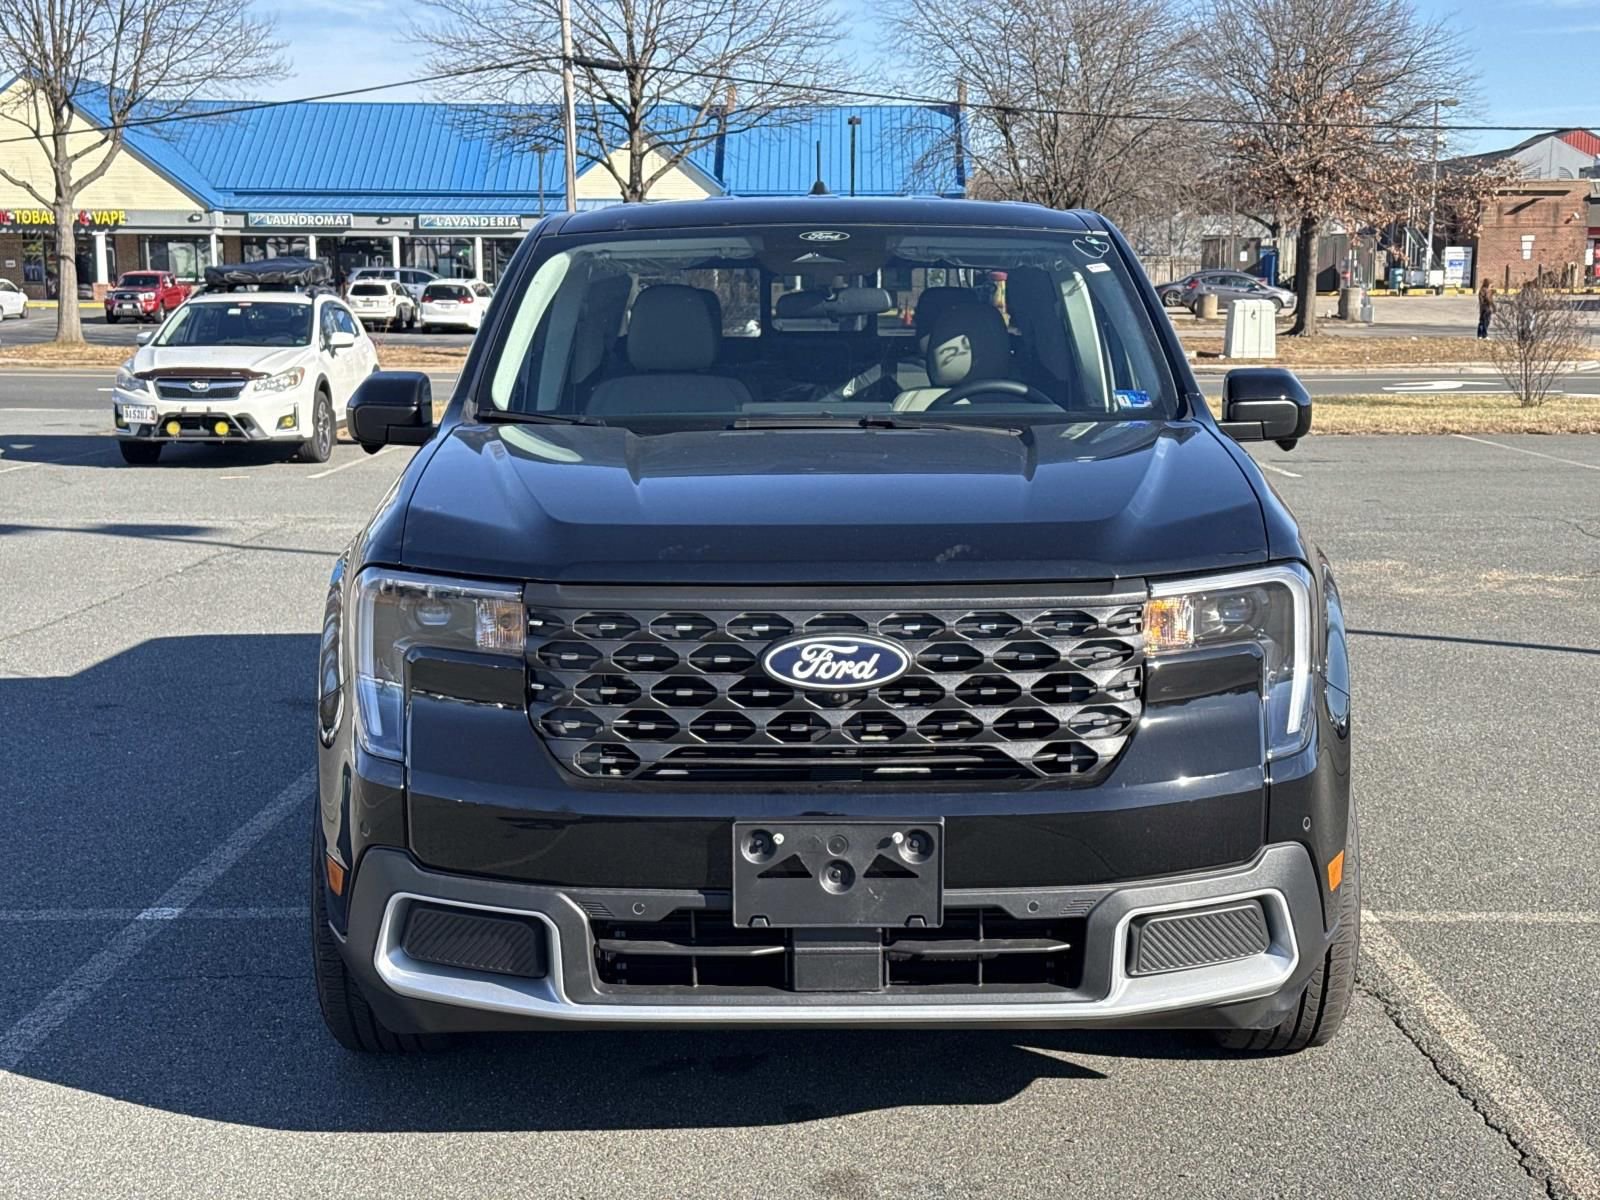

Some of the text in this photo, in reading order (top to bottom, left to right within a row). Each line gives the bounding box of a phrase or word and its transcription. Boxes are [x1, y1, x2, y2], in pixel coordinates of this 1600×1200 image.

[14, 210, 56, 224] TOBAC
[92, 210, 126, 224] VAPE
[266, 215, 349, 225] LAUNDROMAT
[435, 217, 519, 226] LAVANDERIA
[808, 232, 841, 240] Ford
[792, 643, 880, 679] Ford
